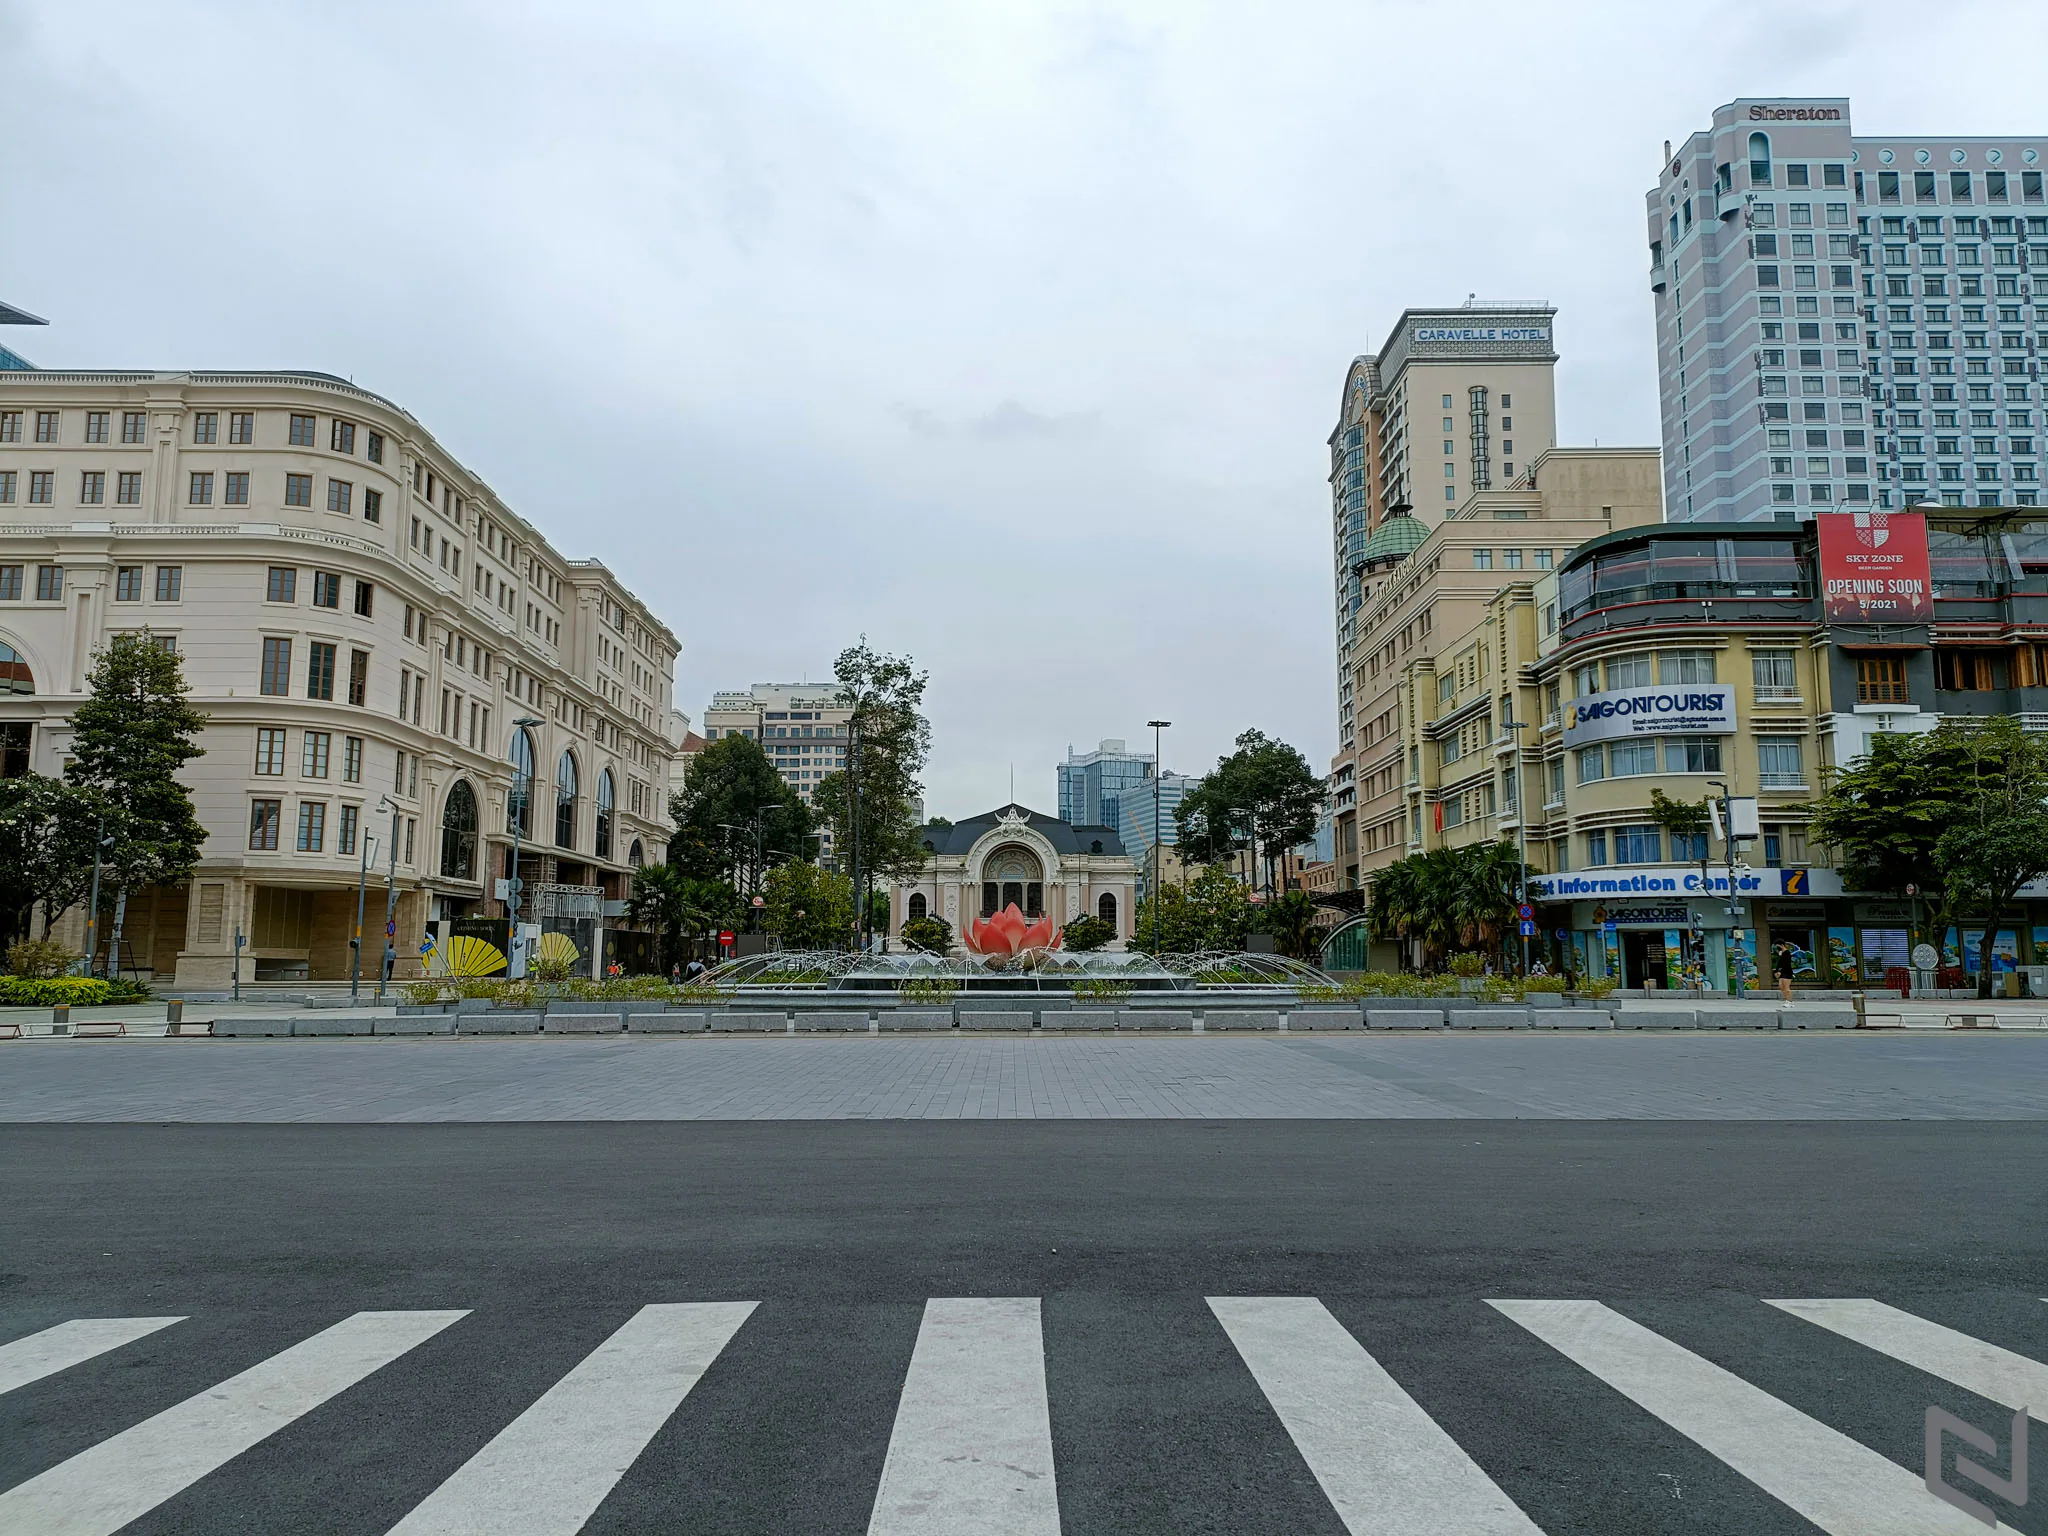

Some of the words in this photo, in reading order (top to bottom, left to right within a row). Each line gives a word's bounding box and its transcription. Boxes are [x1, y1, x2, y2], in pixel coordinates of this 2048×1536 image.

[1749, 105, 1840, 121] Sheraton
[1418, 329, 1496, 340] CARAVELLE
[1501, 328, 1545, 339] HOTEL
[1846, 554, 1869, 563] SKY
[1871, 554, 1904, 563] ZONE
[1827, 579, 1884, 594] OPENING
[1887, 579, 1923, 594] SOON
[1859, 599, 1897, 609] 5/2021
[1577, 693, 1726, 723] SAIGONTOURIST
[1558, 874, 1676, 894] Information
